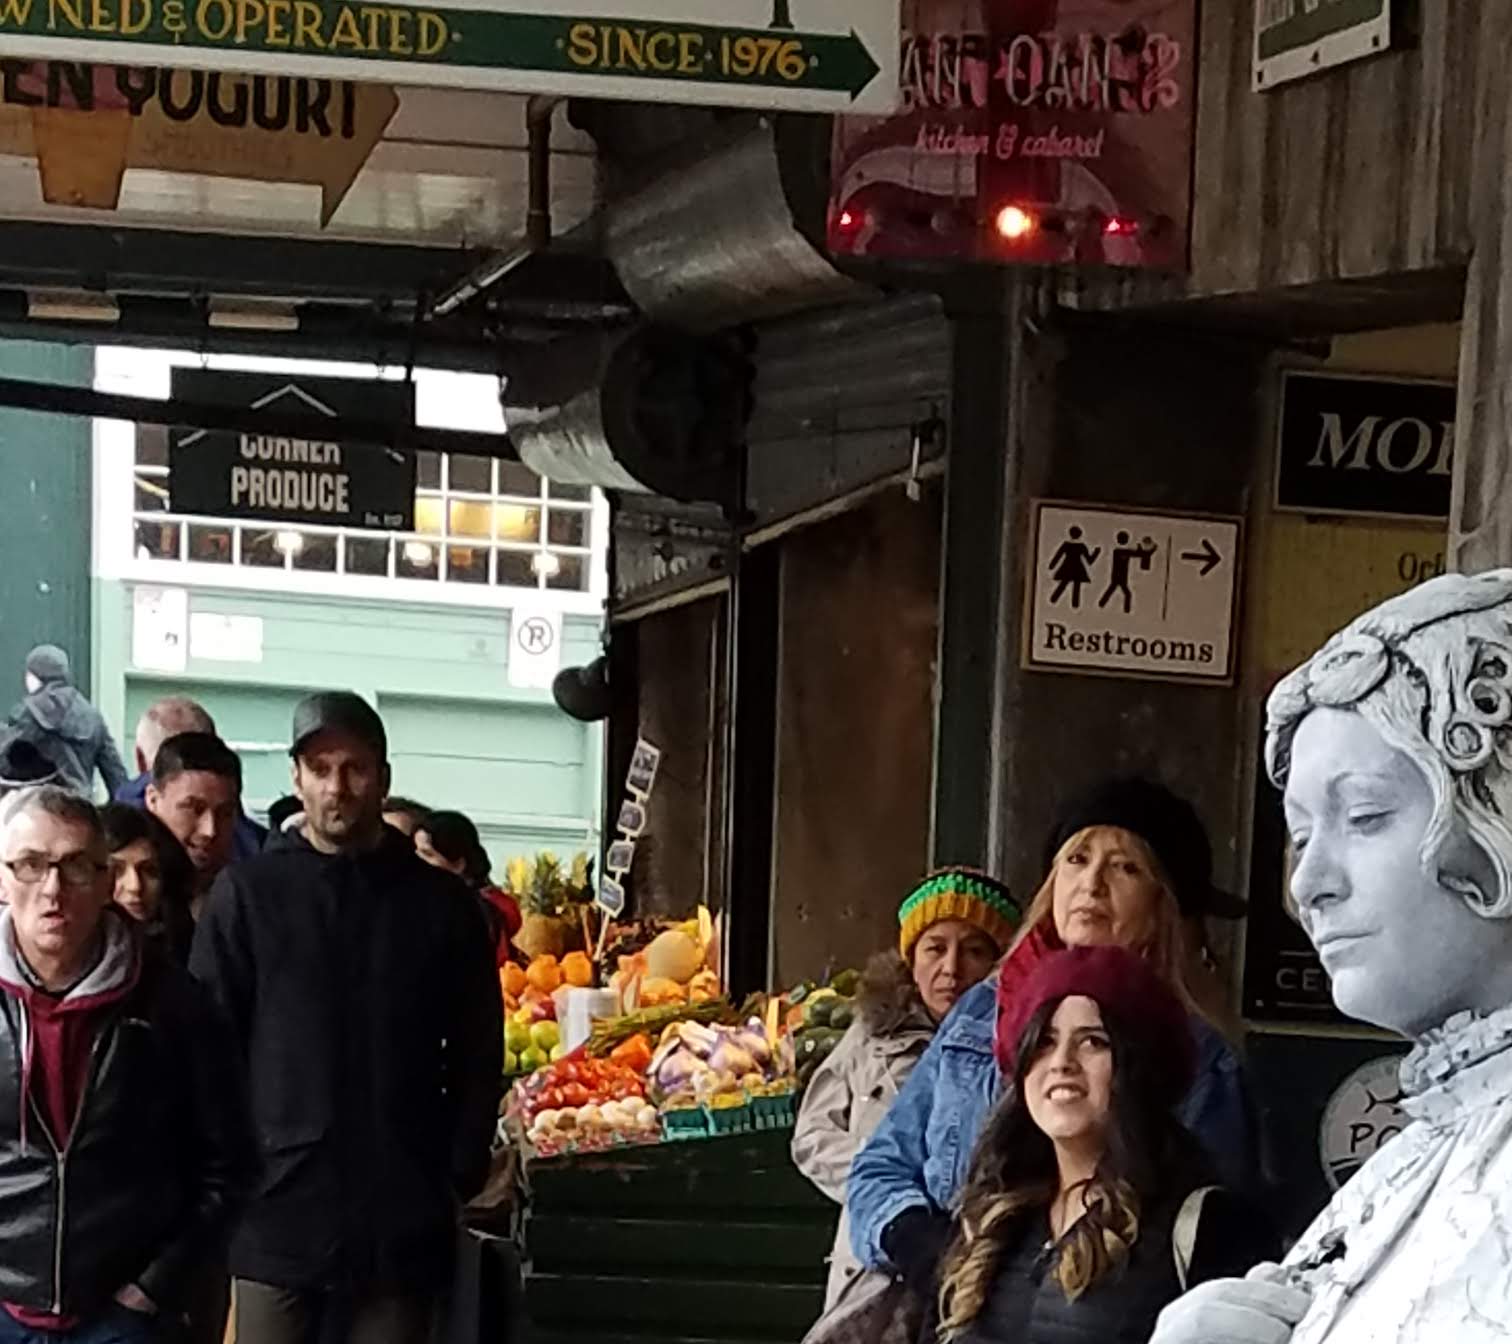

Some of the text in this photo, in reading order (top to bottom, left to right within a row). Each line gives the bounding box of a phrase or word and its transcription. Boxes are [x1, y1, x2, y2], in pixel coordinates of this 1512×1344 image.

[198, 0, 449, 56] OPERATED
[567, 22, 704, 74] SINCE
[719, 35, 808, 81] 1976
[914, 122, 990, 156] kitchen
[1018, 125, 1105, 158] cabaret
[231, 465, 350, 513] PRODUCE
[1043, 622, 1215, 664] Restrooms
